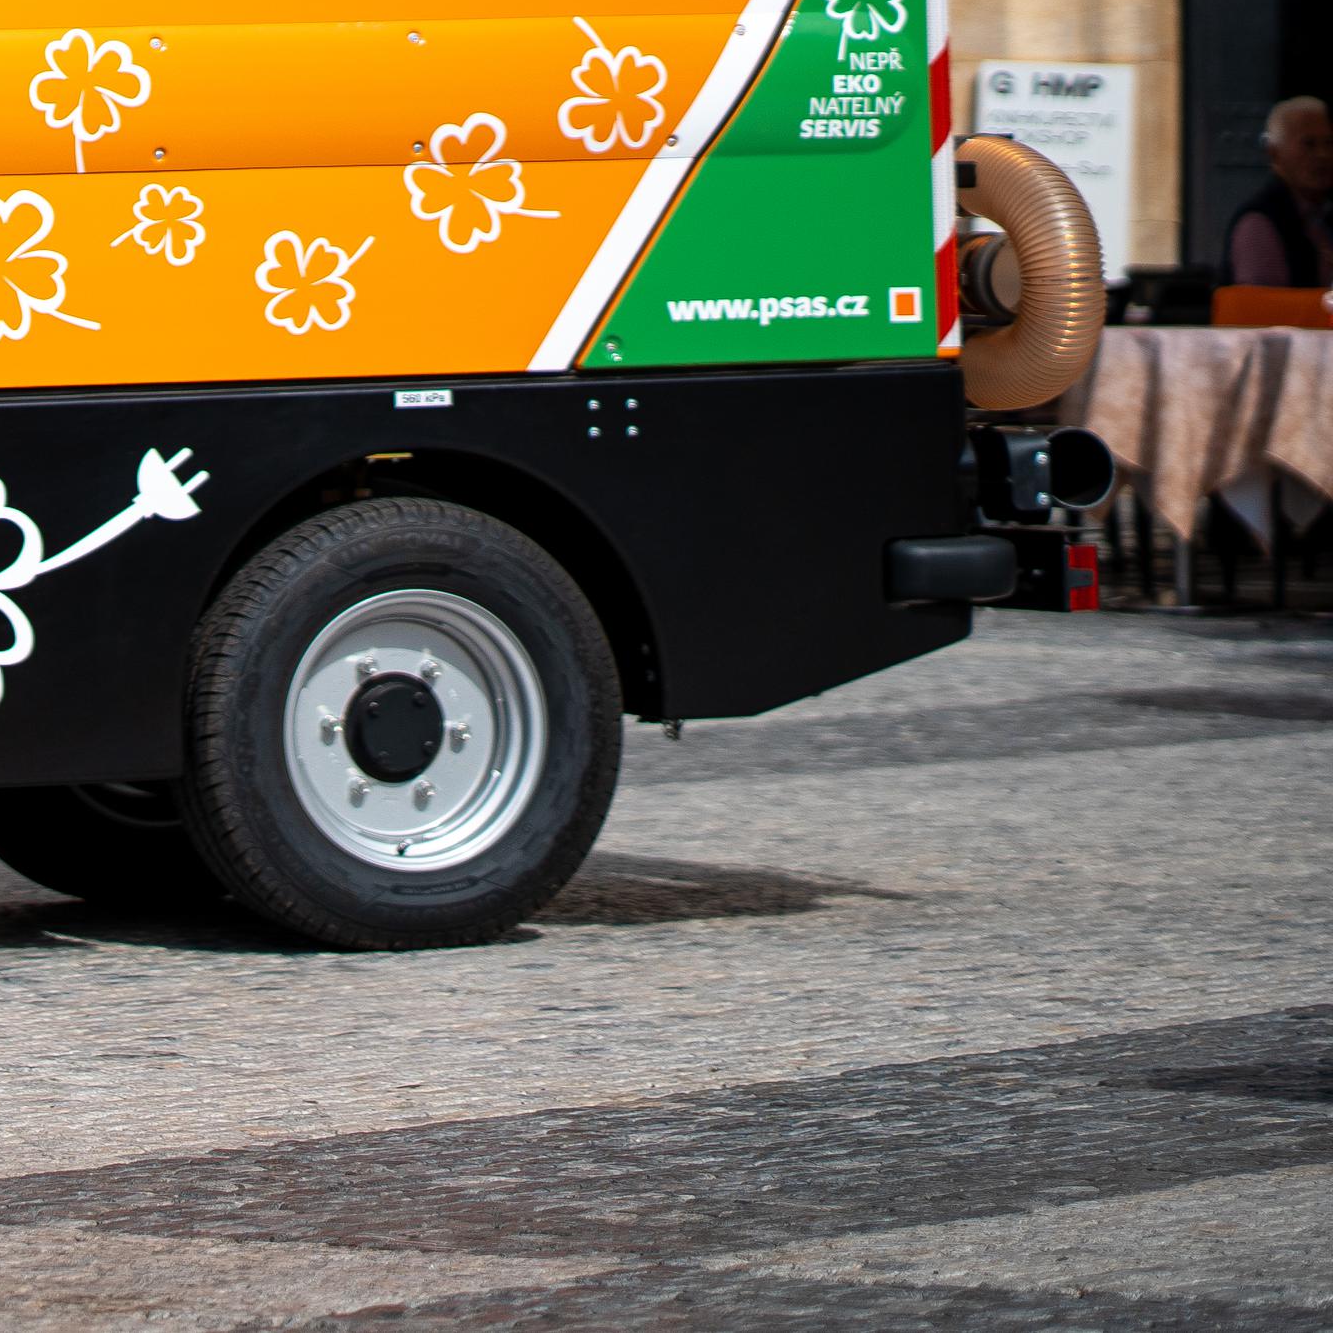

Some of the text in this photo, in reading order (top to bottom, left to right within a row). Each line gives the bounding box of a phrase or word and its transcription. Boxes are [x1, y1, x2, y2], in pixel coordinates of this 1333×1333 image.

[849, 47, 904, 71] NEPŘ
[832, 75, 881, 94] EKO
[989, 70, 1104, 97] G HMP
[809, 92, 906, 116] NATELNÝ
[799, 118, 881, 139] SERVIS
[667, 294, 870, 326] www.psas.cz
